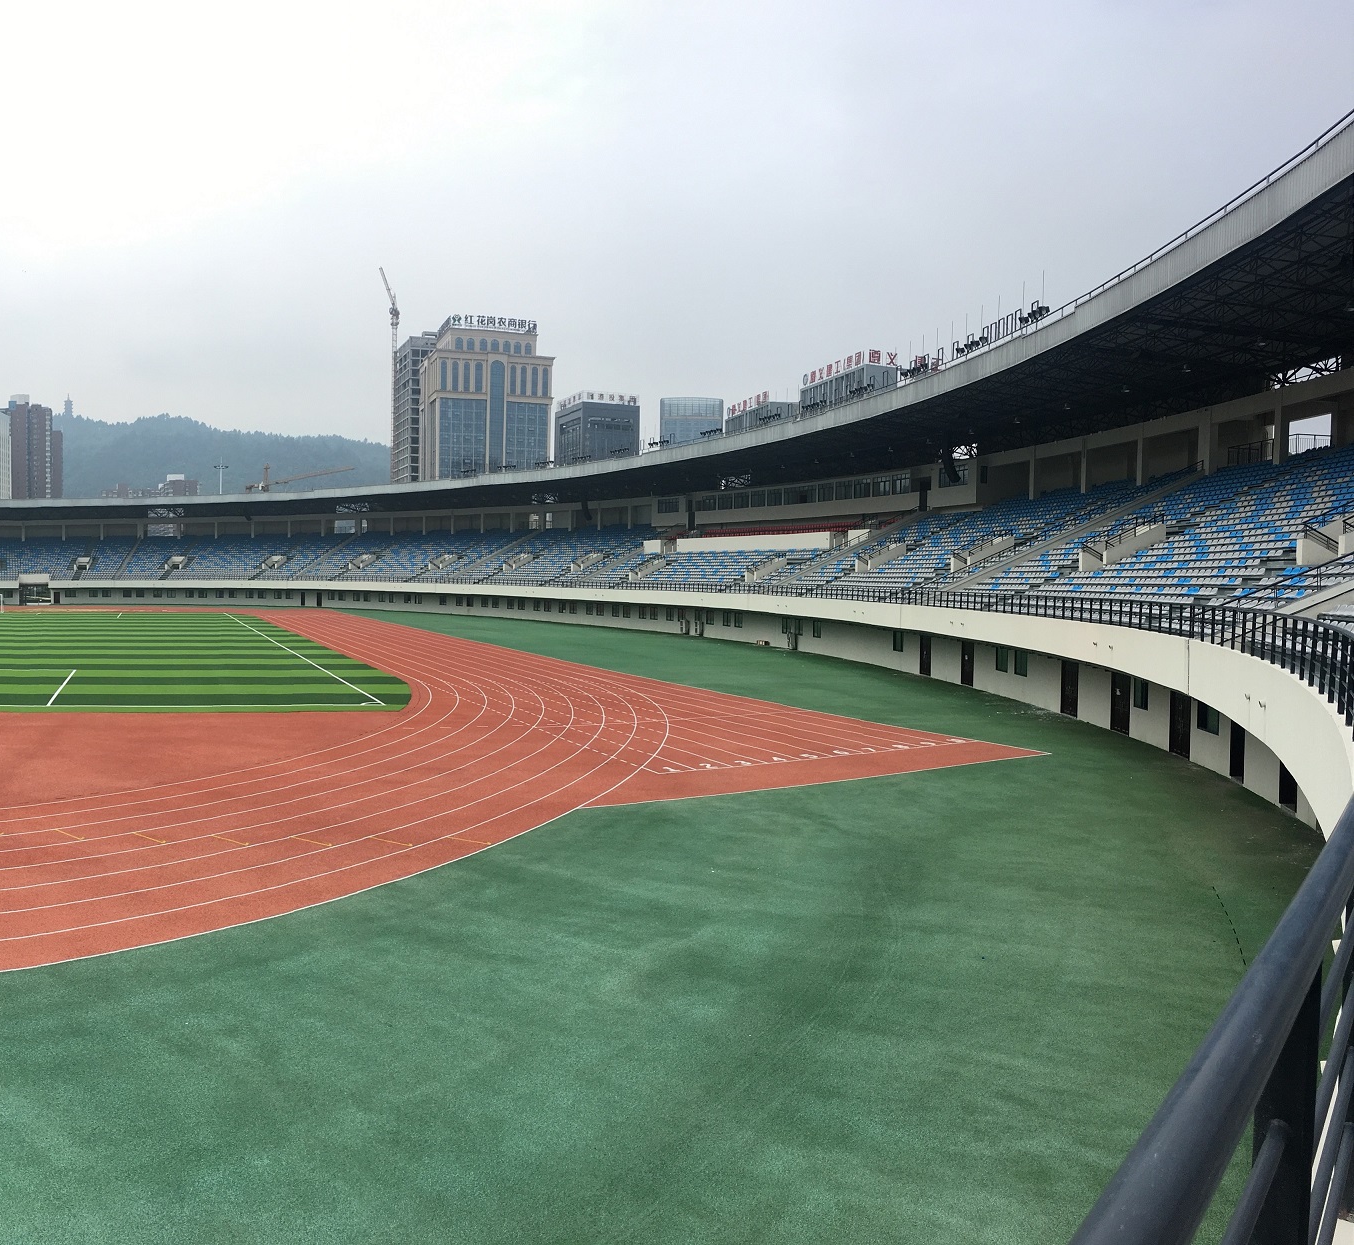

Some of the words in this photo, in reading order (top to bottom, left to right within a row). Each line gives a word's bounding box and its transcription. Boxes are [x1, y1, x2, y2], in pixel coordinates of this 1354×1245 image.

[464, 314, 537, 330] 红花岗农商银行
